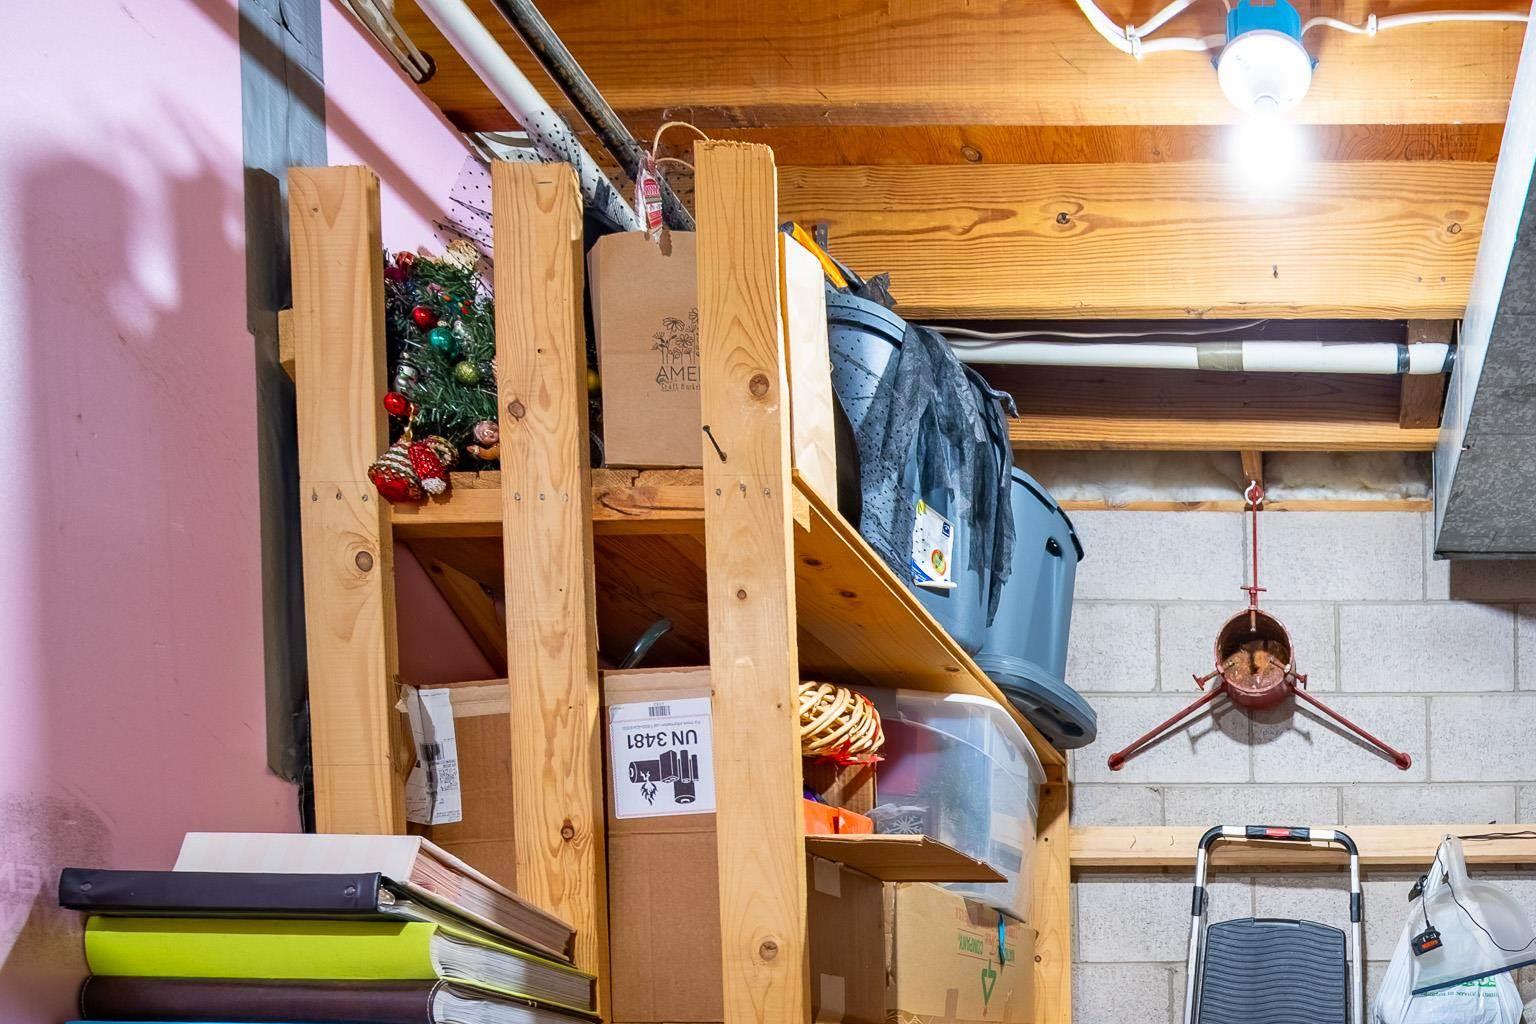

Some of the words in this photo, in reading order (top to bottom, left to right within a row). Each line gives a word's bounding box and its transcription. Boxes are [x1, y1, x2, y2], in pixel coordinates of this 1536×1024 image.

[656, 365, 701, 384] AME
[627, 731, 668, 750] 3481
[671, 729, 698, 746] UN
